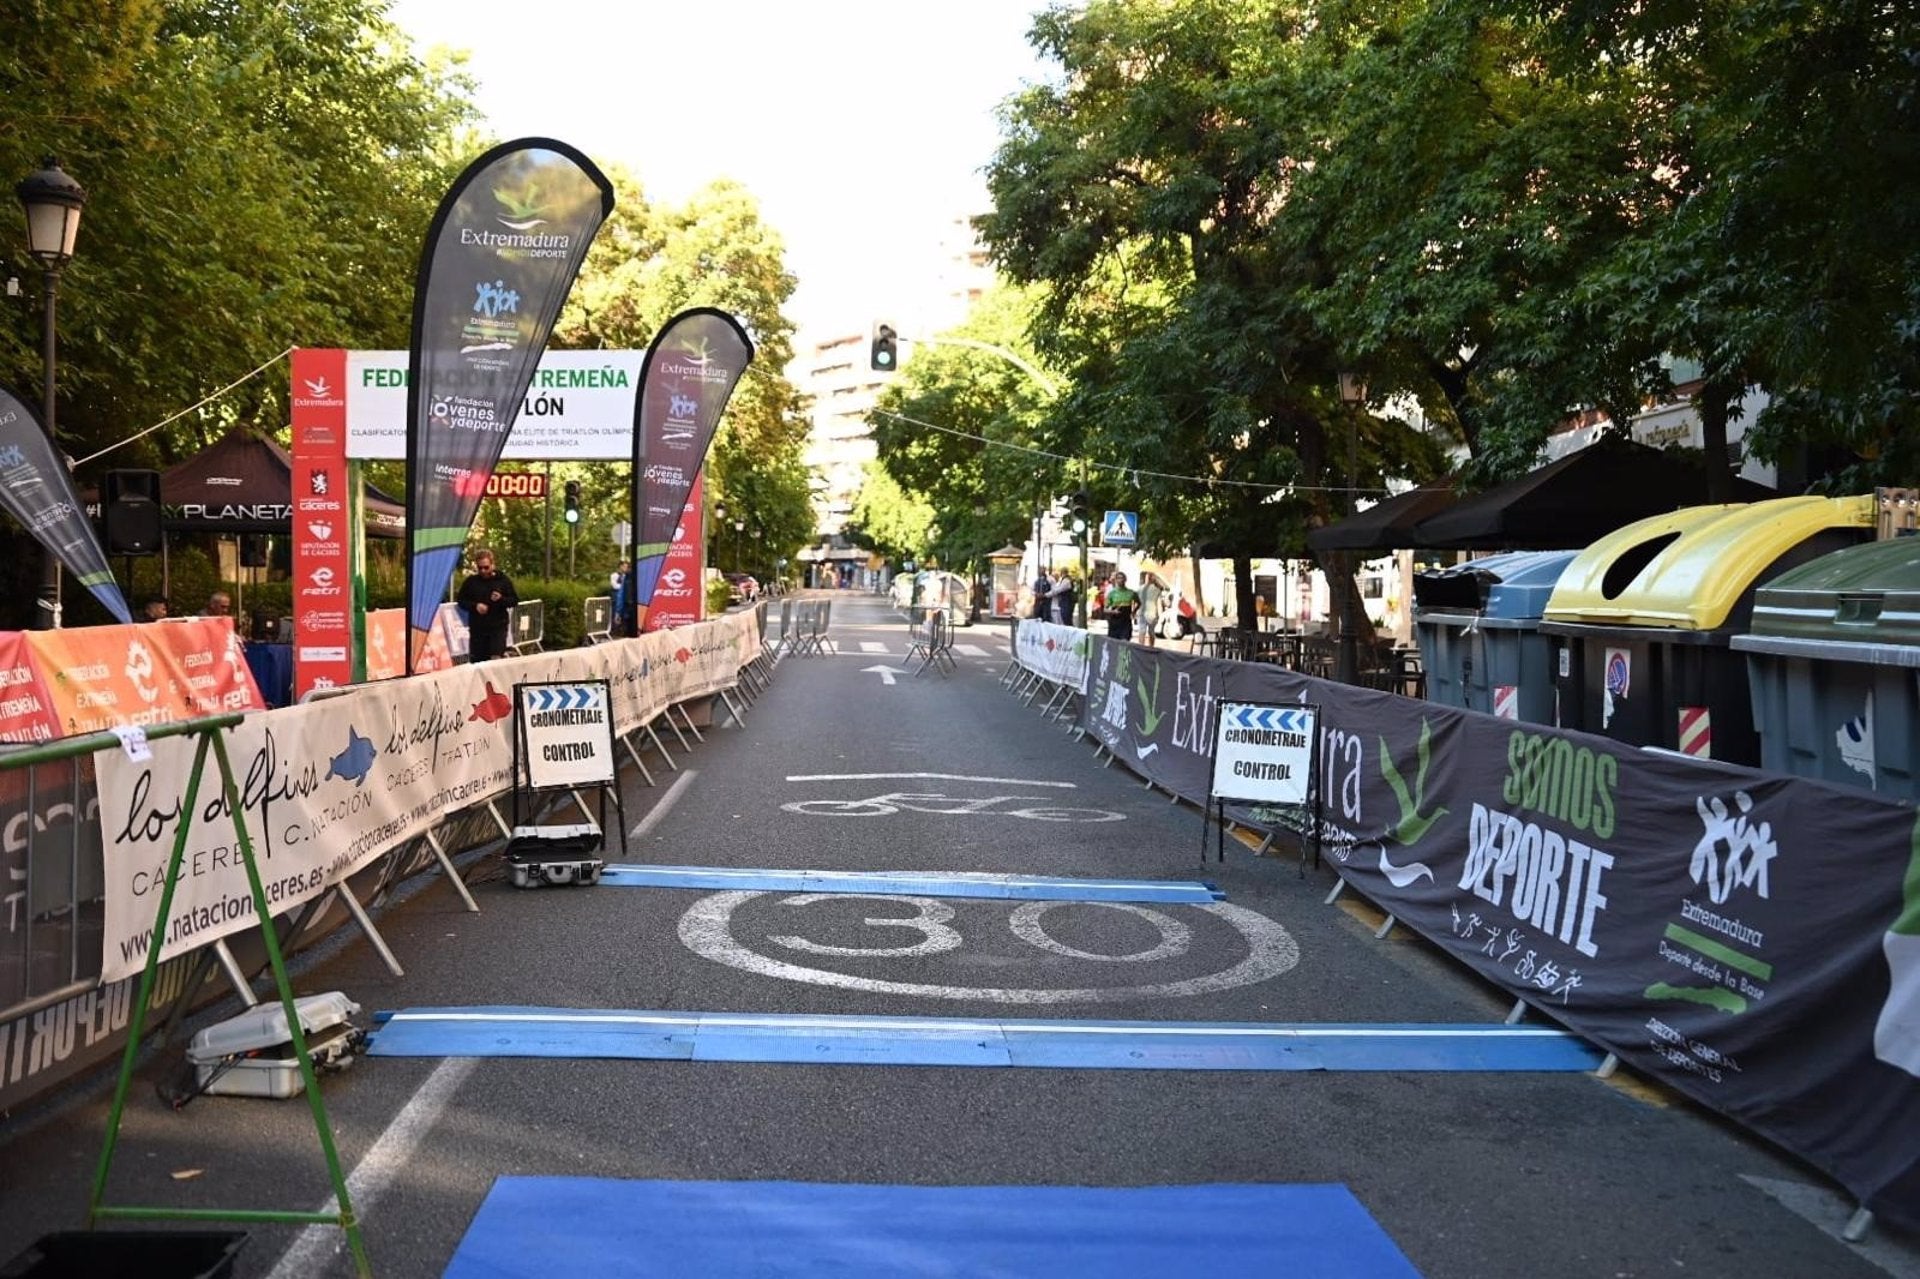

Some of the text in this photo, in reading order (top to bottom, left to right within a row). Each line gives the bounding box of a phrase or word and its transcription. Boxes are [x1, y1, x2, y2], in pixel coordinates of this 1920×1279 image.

[461, 228, 569, 248] Extremadura
[518, 366, 630, 388] TREMEÑA
[660, 362, 728, 377] Extremadura
[524, 391, 565, 417] LÓN
[602, 427, 636, 436] OLÍMPIC
[530, 708, 604, 728] CRONOMETRAJE
[1225, 729, 1306, 749] CRONOMETRAJE
[543, 741, 596, 762] CONTROL
[1234, 760, 1291, 781] CONTROL
[203, 727, 319, 859] dlfines
[1503, 729, 1618, 839] SOMOS
[1457, 802, 1615, 958] DEPORTE
[1680, 898, 1764, 949] Extremadura
[1692, 956, 1722, 982] desde
[1725, 970, 1737, 989] la
[1740, 976, 1765, 1001] Base
